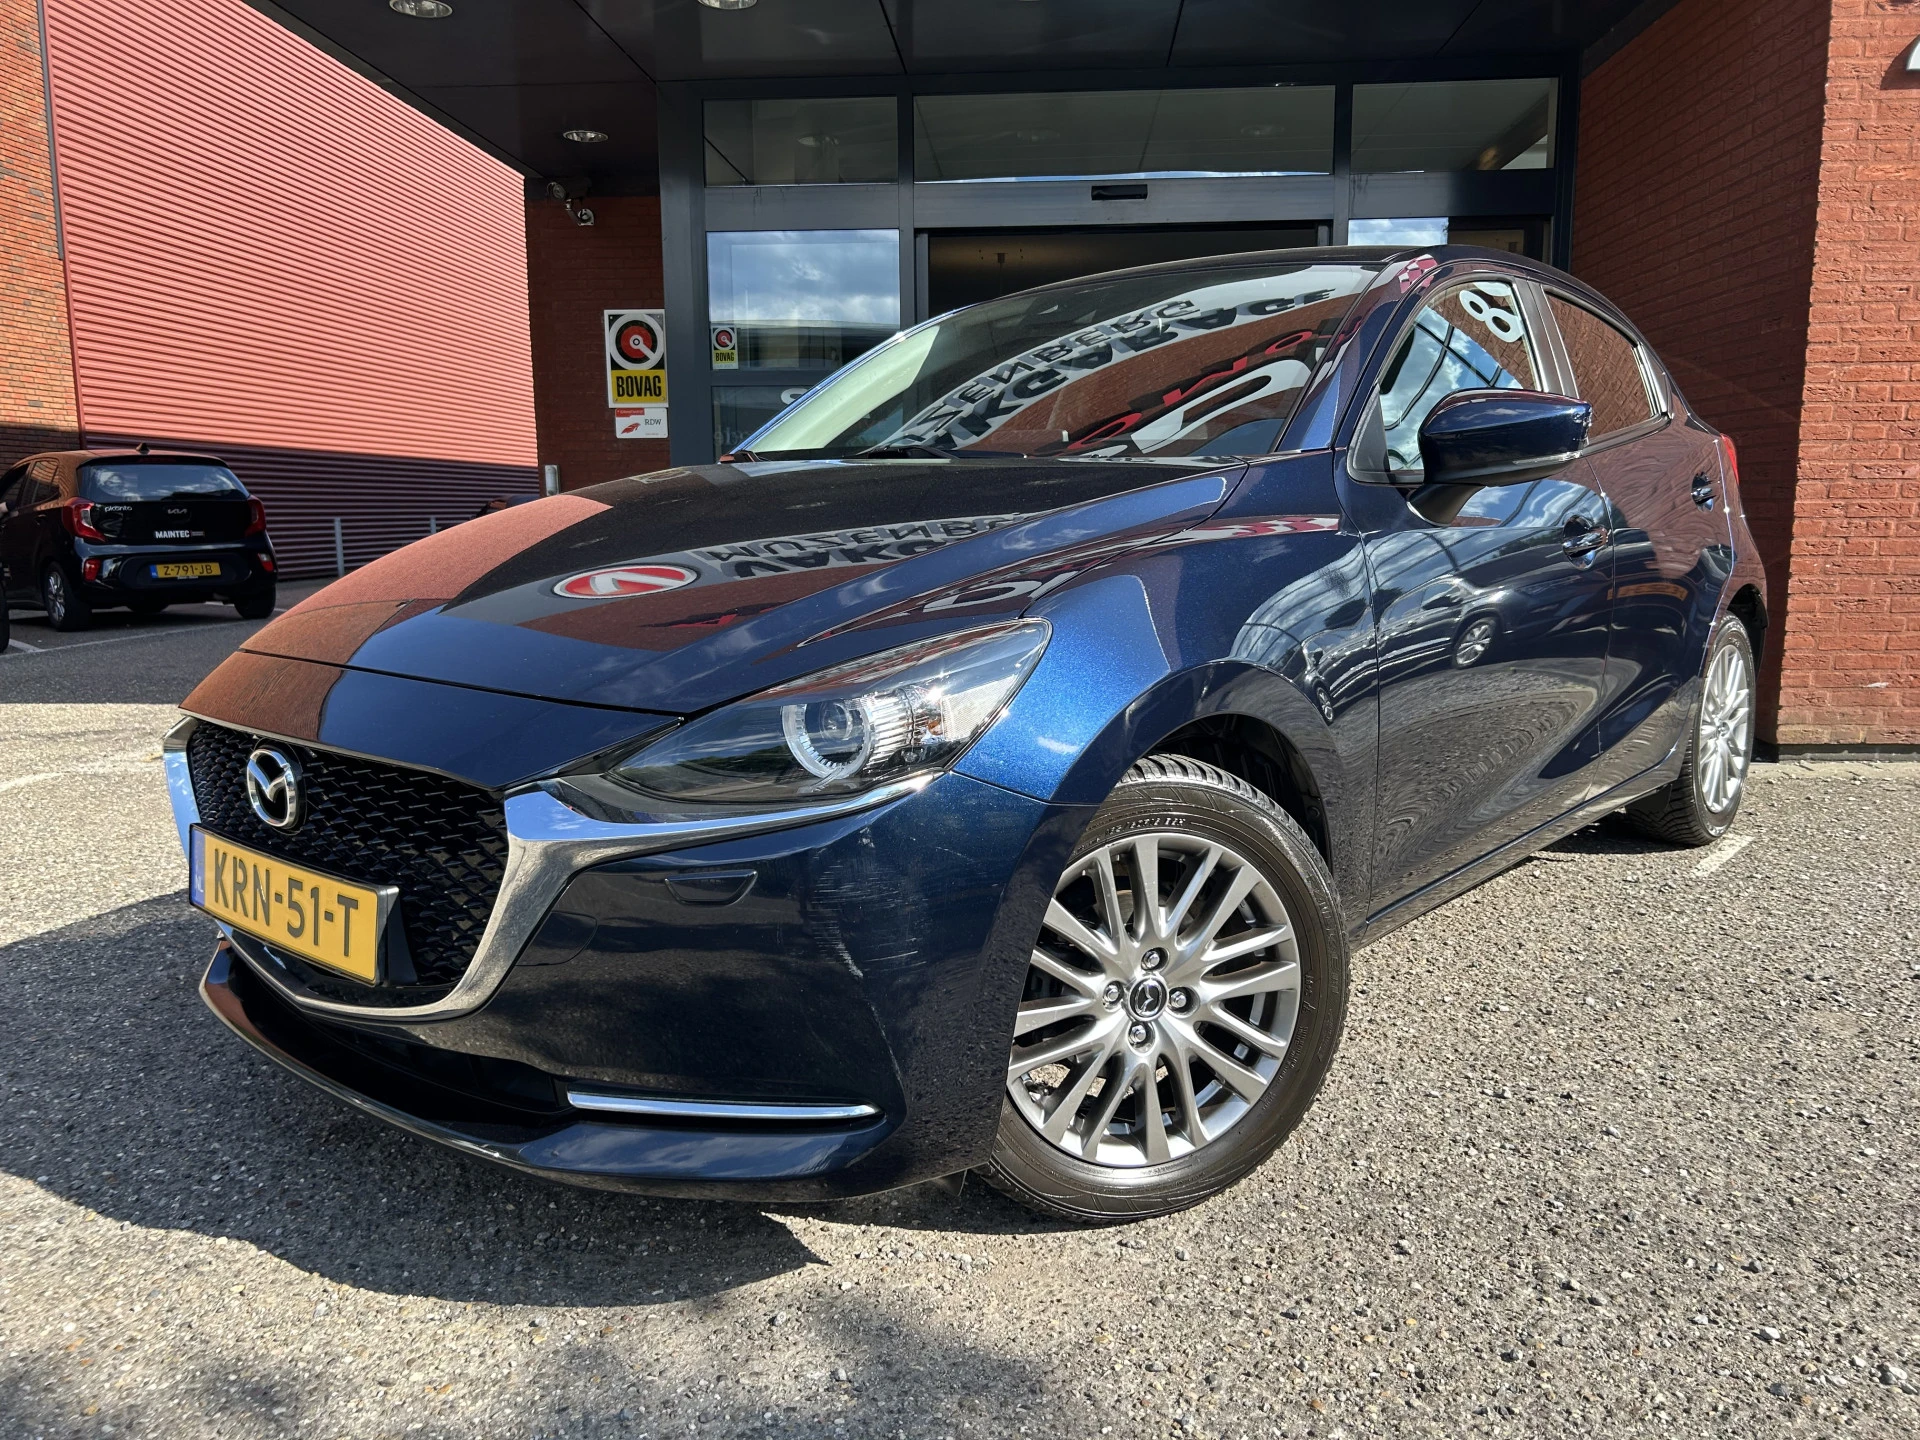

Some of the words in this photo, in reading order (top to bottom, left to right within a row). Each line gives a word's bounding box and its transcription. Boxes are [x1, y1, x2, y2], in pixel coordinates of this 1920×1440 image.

[715, 352, 735, 362] BOVAG
[616, 375, 662, 398] BOVAG
[645, 418, 662, 426] RDW
[155, 530, 190, 539] MAINTEC
[164, 564, 213, 576] Z-791-JB
[214, 847, 359, 958] KRN-51-T
